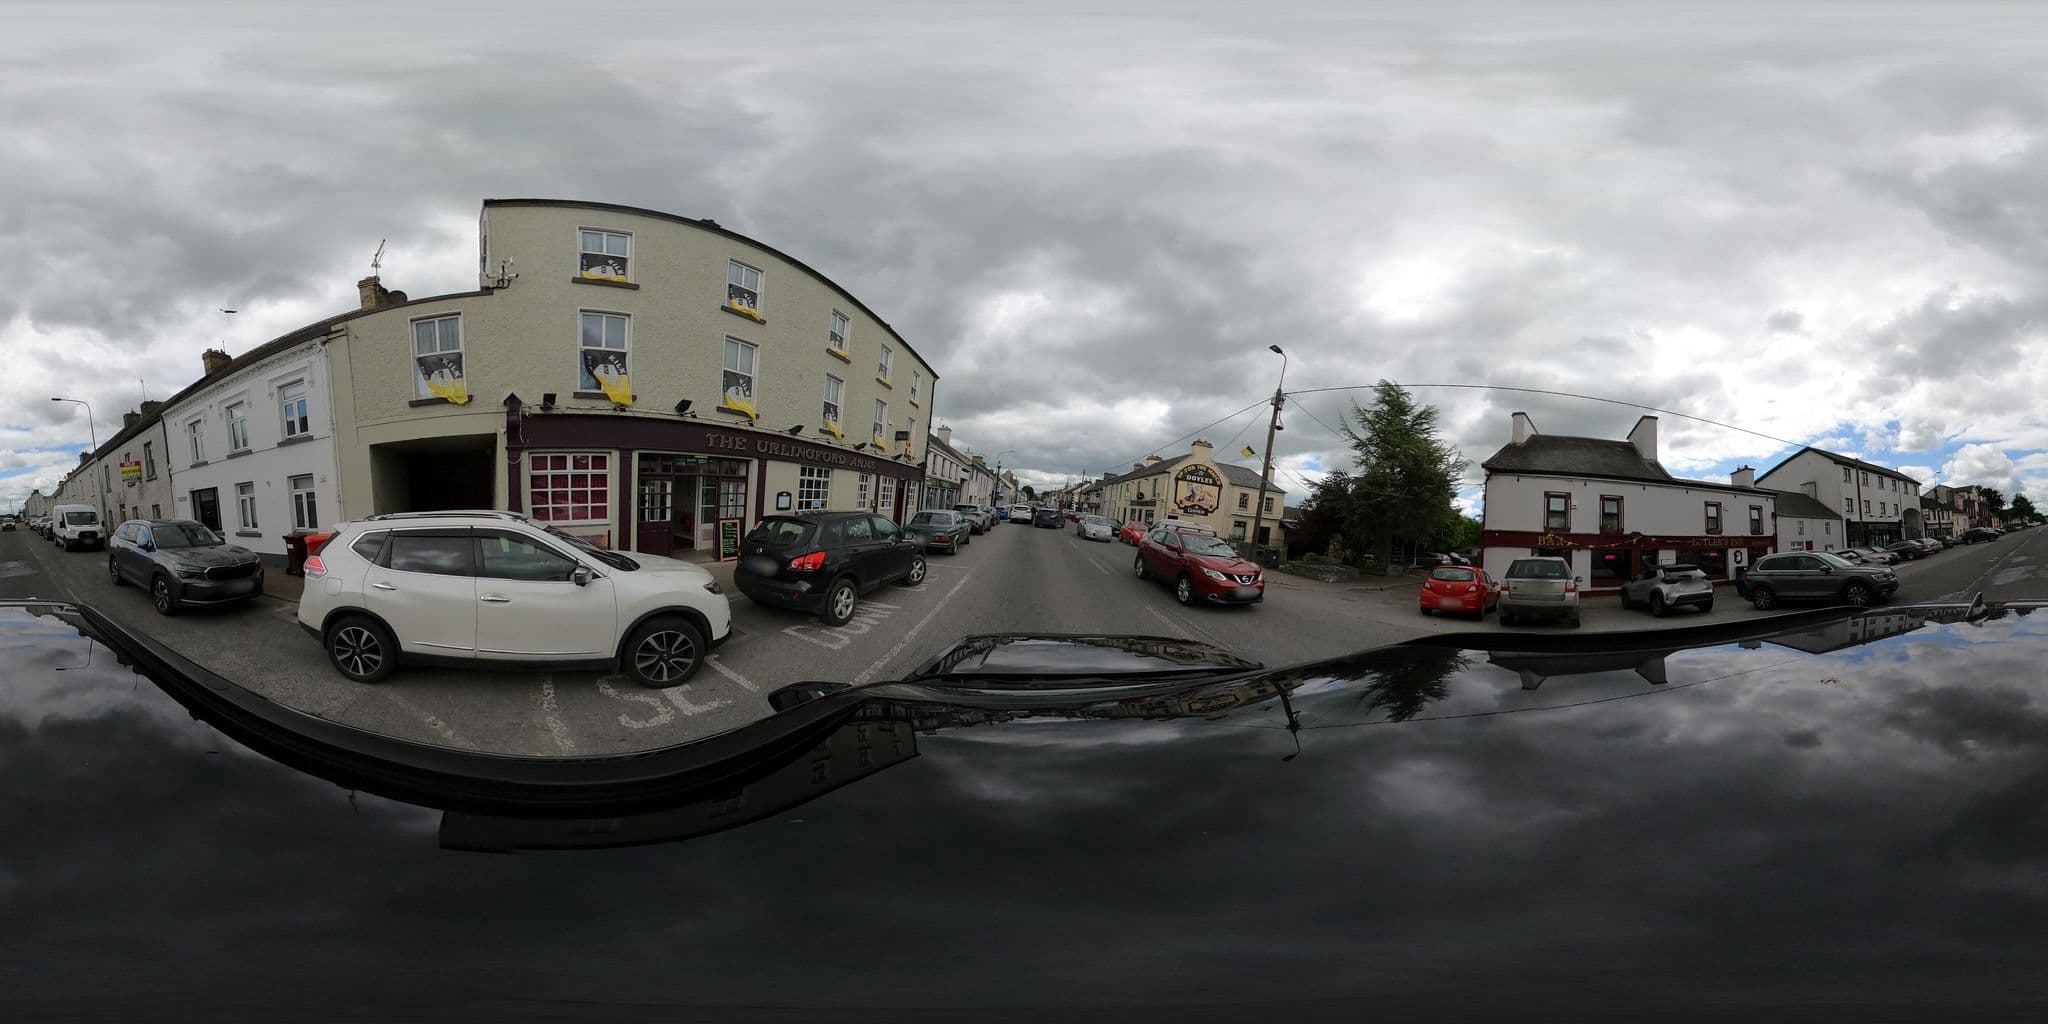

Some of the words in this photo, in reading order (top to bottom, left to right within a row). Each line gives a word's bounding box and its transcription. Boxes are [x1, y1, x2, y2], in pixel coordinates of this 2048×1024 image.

[706, 433, 747, 450] THE
[756, 440, 846, 465] URLINGFORD
[849, 457, 876, 470] ARMS
